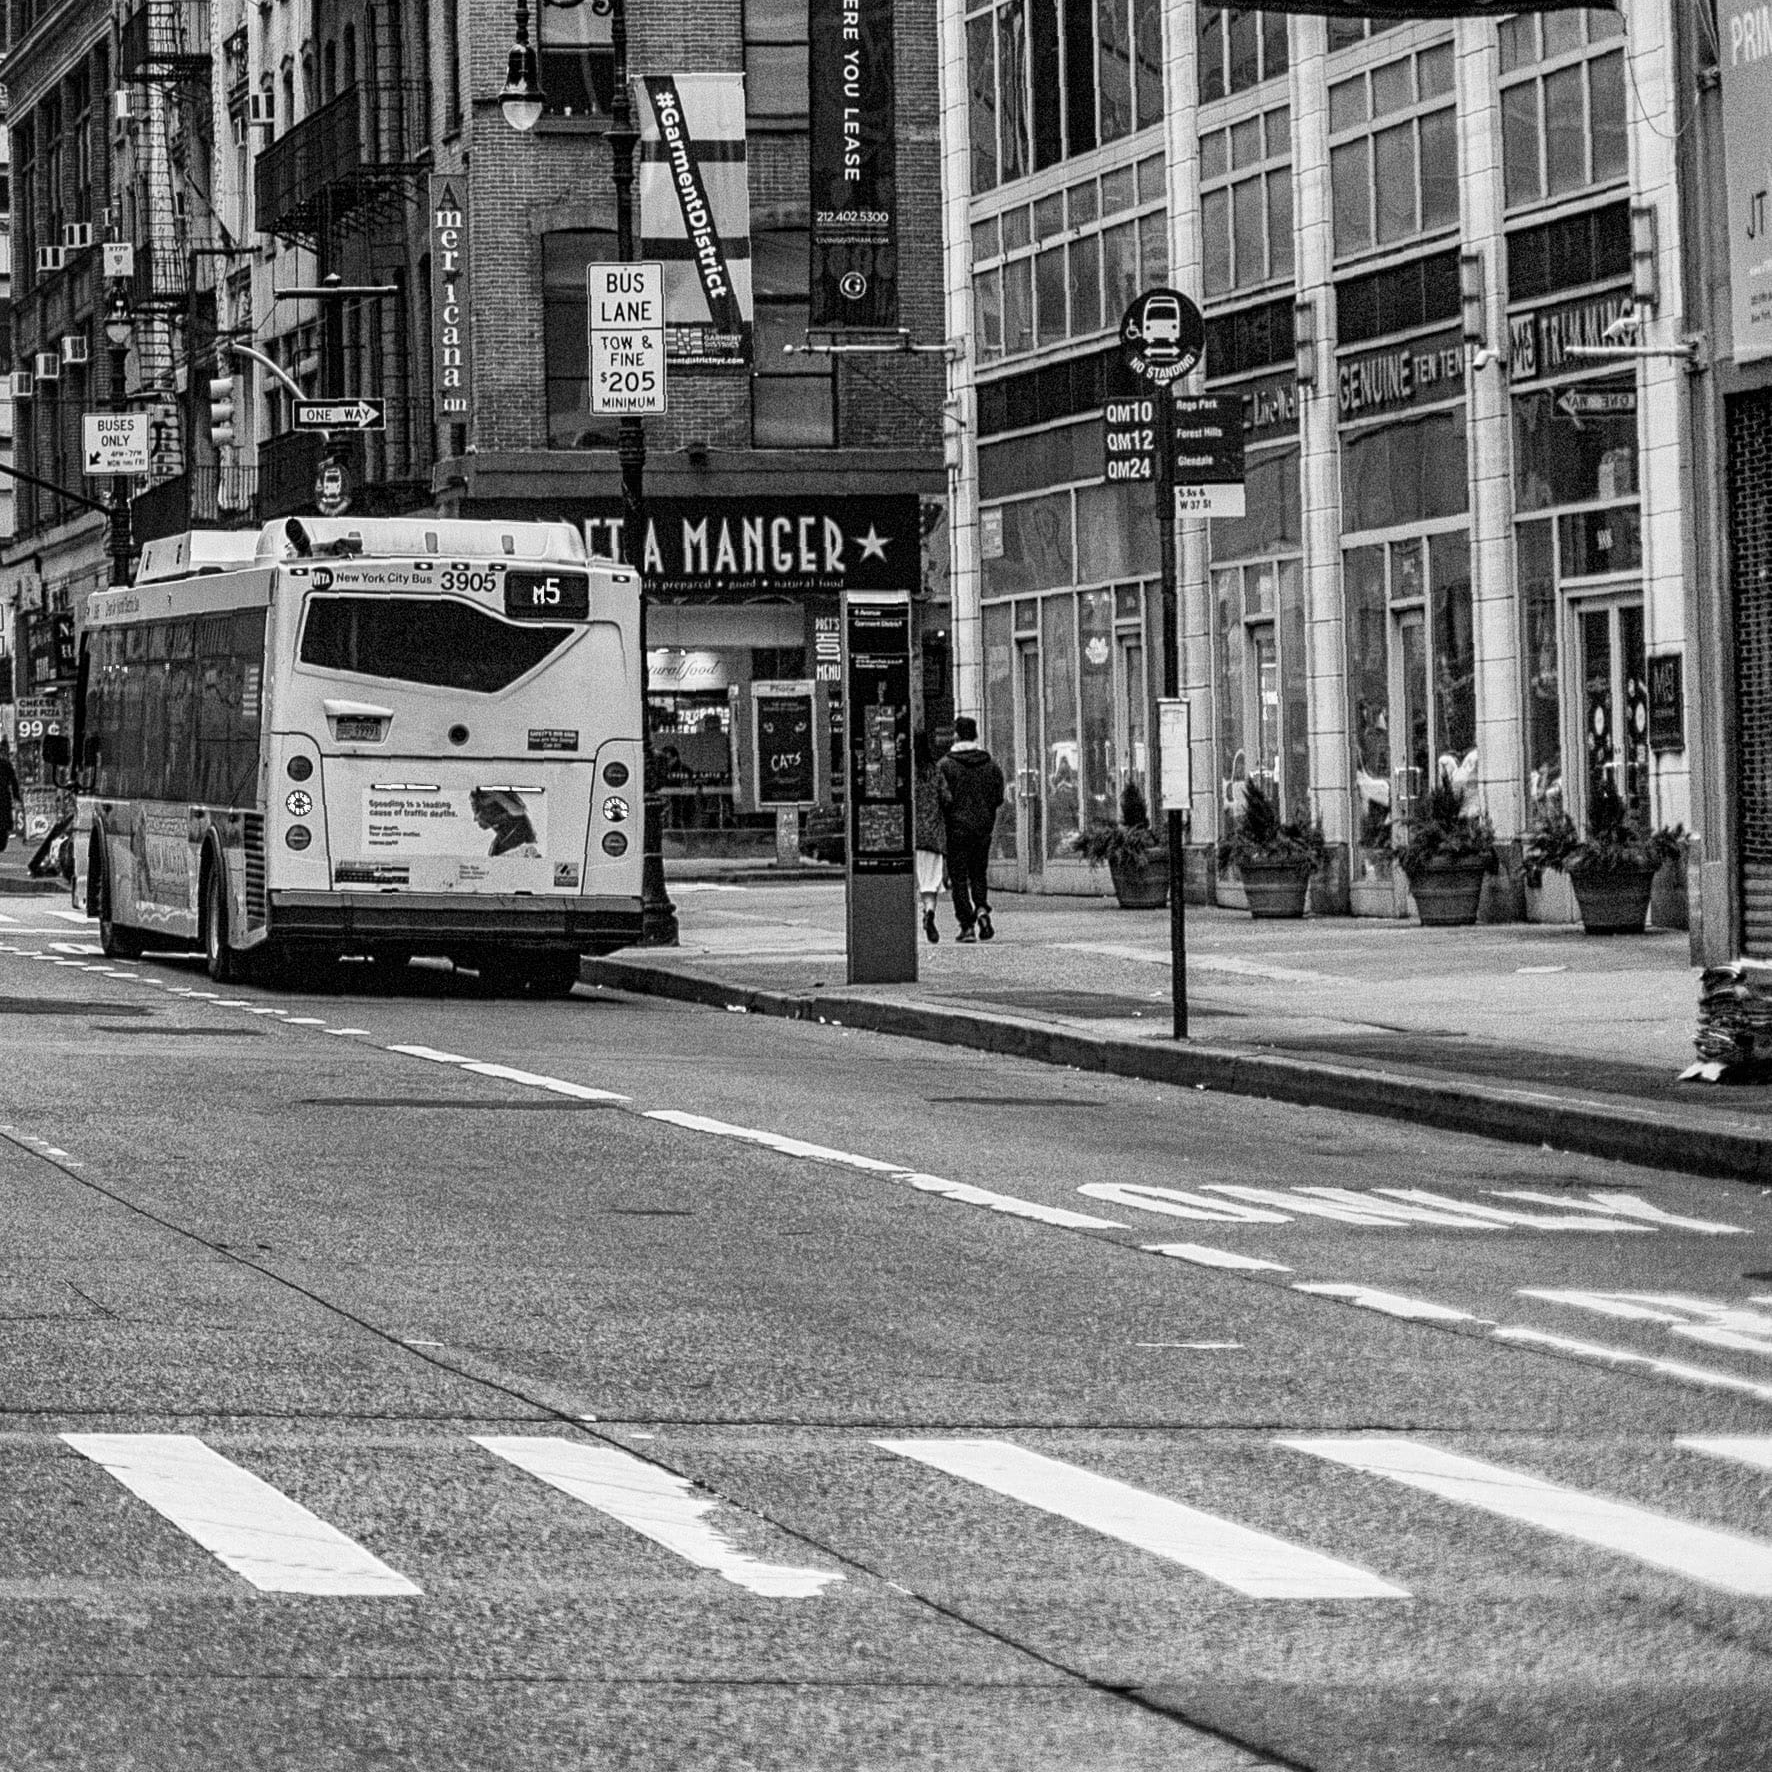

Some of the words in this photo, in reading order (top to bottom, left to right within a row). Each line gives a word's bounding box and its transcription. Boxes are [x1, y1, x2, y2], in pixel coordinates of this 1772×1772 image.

[844, 50, 860, 97] YOU
[845, 108, 860, 181] LEASE
[656, 91, 728, 299] #GarmentDistrict
[817, 211, 888, 222] 212.402.5300
[606, 273, 644, 294] BUS
[601, 301, 652, 322] LANE
[601, 336, 632, 350] TOW
[642, 335, 653, 349] &
[610, 352, 644, 367] FINE
[1129, 356, 1146, 374] NO
[1146, 353, 1196, 379] STANDING
[600, 371, 656, 393] $205
[1337, 350, 1413, 412] GENUINE
[1413, 357, 1437, 385] TEN
[1439, 346, 1464, 378] TEN
[602, 397, 656, 408] MINIMUM
[1106, 401, 1153, 423] QM10
[1176, 400, 1197, 412] Rego
[1199, 399, 1218, 409] Park
[306, 409, 332, 421] ONE
[344, 408, 370, 421] WAY
[97, 420, 134, 433] BUSES
[101, 435, 130, 447] ONLY
[1107, 430, 1154, 451] QM12
[1177, 428, 1202, 438] Forest
[1204, 427, 1223, 437] Hills
[1107, 458, 1151, 479] QM24
[1177, 455, 1213, 466] Glendale
[1180, 500, 1188, 509] W
[1190, 500, 1200, 509] 37
[644, 518, 664, 573] A
[683, 516, 846, 574] MANGER
[337, 573, 360, 584] New
[361, 573, 387, 585] York
[389, 573, 410, 586] City
[412, 574, 432, 585] Bus
[440, 571, 497, 592] 3905
[533, 577, 560, 604] M5
[662, 580, 711, 590] prepared
[774, 578, 814, 588] natural
[818, 579, 844, 588] food
[815, 633, 841, 662] HOT
[816, 664, 841, 680] MENU
[19, 699, 56, 707] CHEESE
[18, 709, 37, 717] SLICE
[40, 709, 60, 717] PIZZA
[19, 721, 43, 737] 99
[771, 752, 801, 771] CATS
[369, 799, 404, 809] Speeding
[423, 800, 451, 809] leading
[404, 809, 428, 817] traffic
[1076, 1182, 1753, 1233] ONLY
